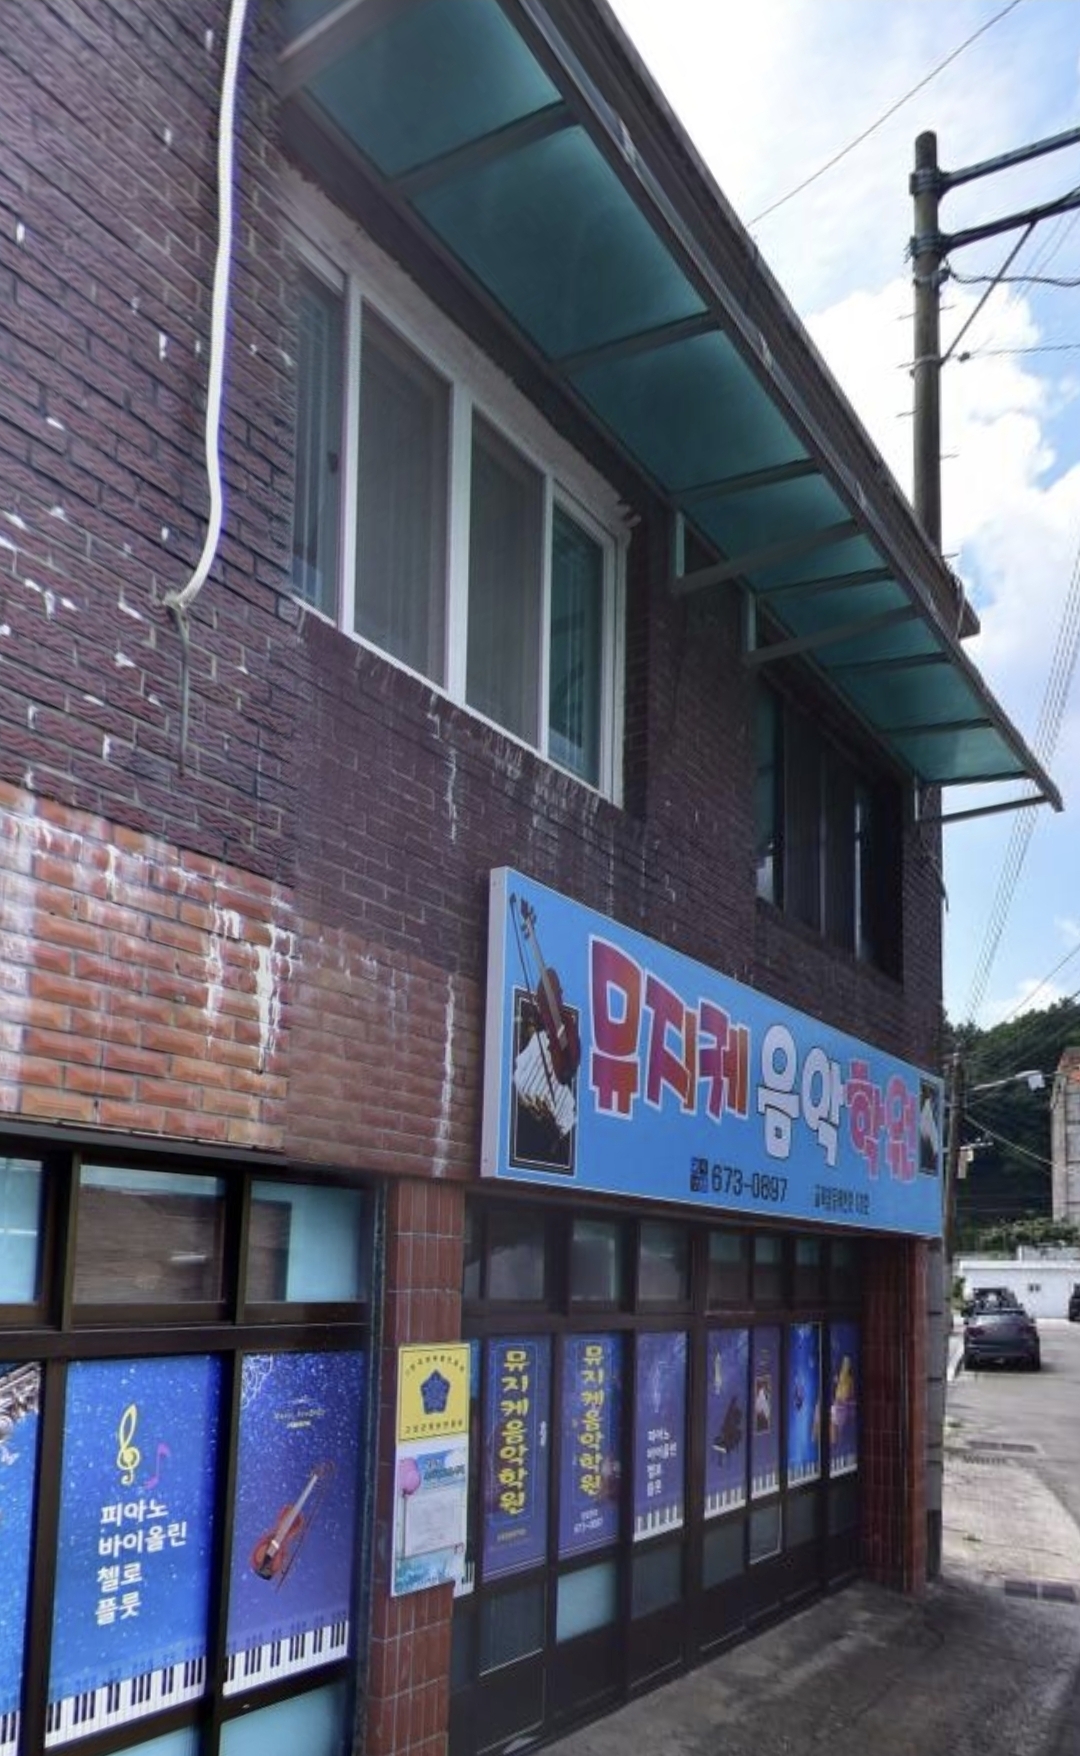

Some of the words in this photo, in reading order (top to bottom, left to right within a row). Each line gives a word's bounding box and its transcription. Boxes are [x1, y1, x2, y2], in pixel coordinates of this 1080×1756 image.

[589, 934, 750, 1123] 뮤지케
[100, 1499, 169, 1527] 피아노
[98, 1521, 187, 1558] 바이올린
[96, 1562, 143, 1593] 첼로
[94, 1591, 142, 1626] 플룻
